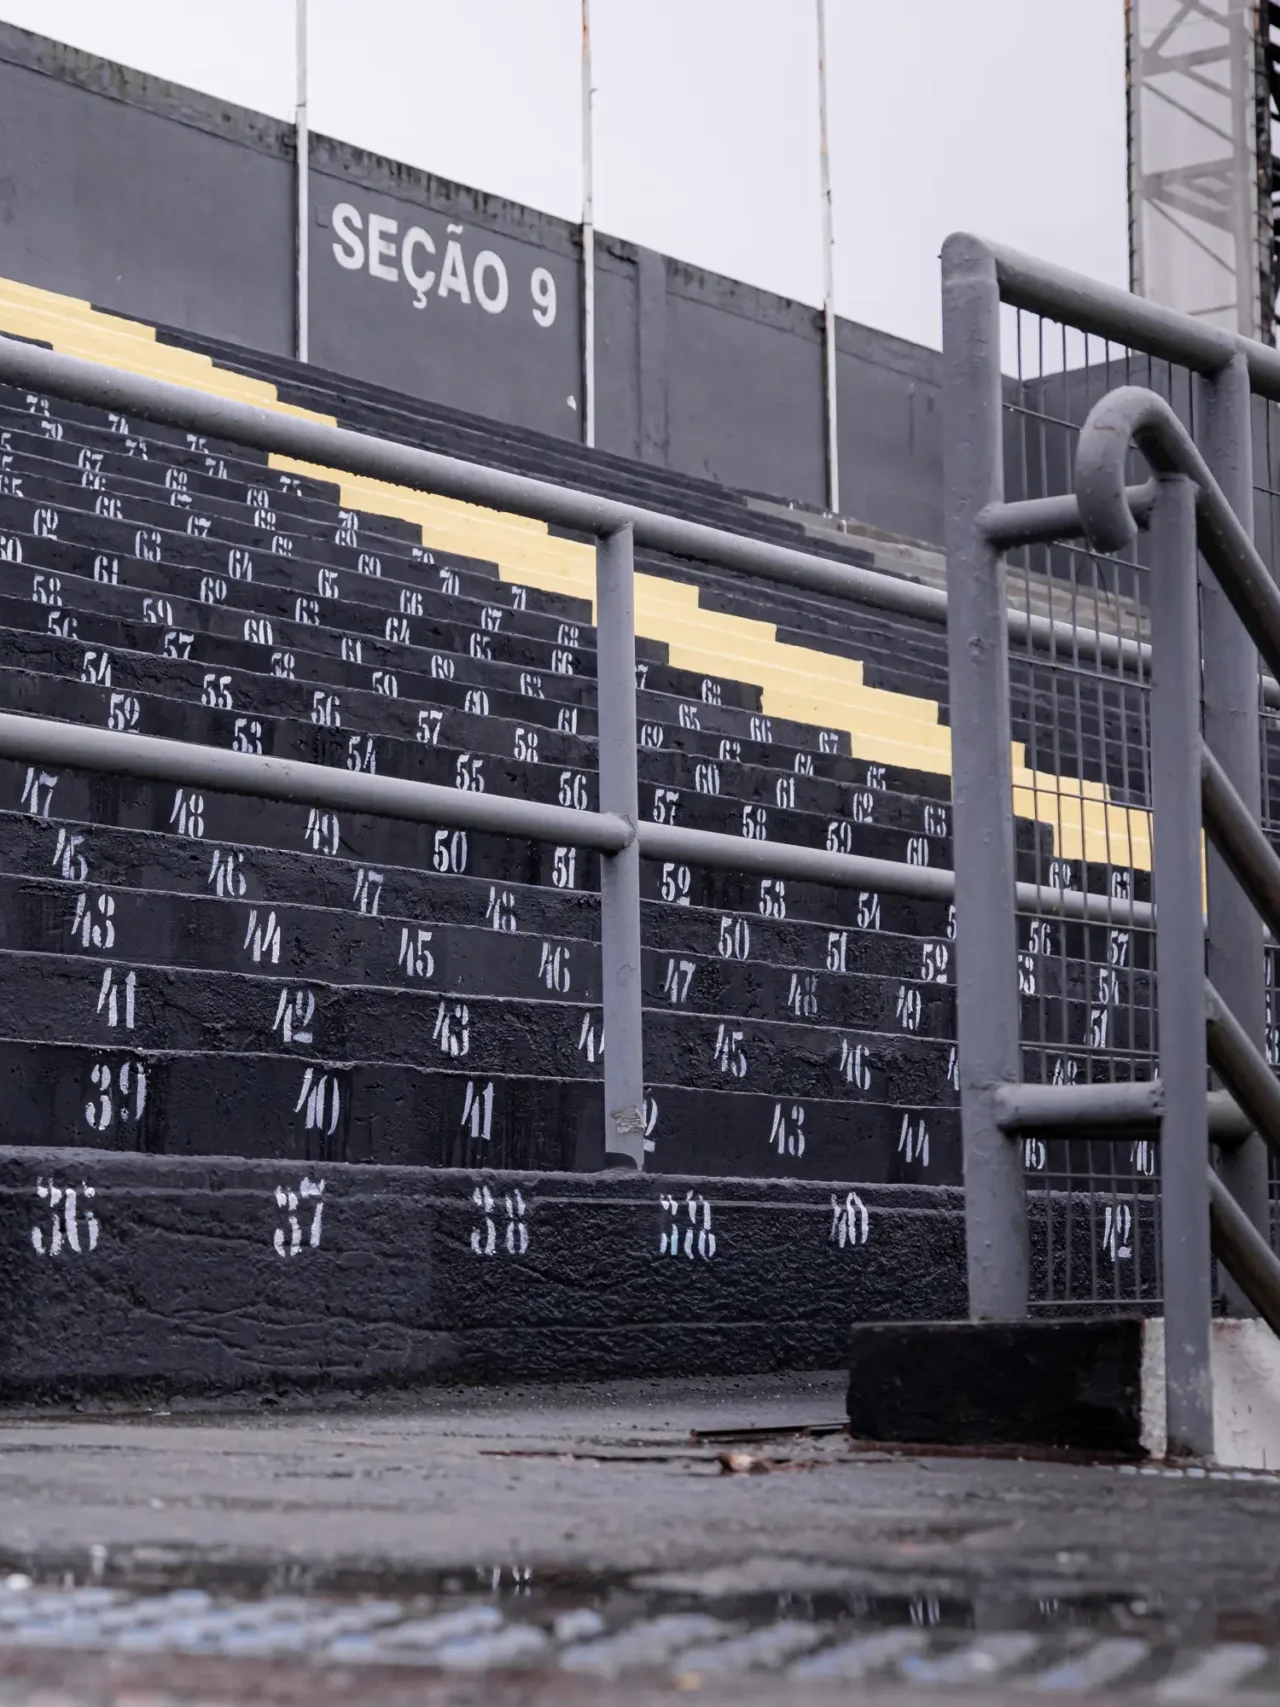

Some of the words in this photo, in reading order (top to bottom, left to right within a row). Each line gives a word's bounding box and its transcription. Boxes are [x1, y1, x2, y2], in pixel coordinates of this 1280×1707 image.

[332, 203, 509, 314] SEÇÃO
[531, 267, 557, 327] 9
[94, 556, 119, 586] 61
[228, 549, 252, 582] 64
[318, 569, 338, 599] 65
[144, 598, 173, 627] 59
[81, 651, 111, 687] 54
[201, 673, 232, 709] 55
[311, 691, 341, 727] 56
[232, 718, 262, 754] 53
[418, 711, 443, 745] 57
[514, 728, 538, 762] 58
[347, 736, 376, 774] 54
[456, 753, 484, 793] 55
[21, 767, 57, 818] 47
[558, 771, 587, 811] 56
[695, 764, 720, 796] 60
[776, 777, 795, 809] 61
[170, 789, 204, 837] 48
[652, 789, 679, 826] 57
[742, 805, 767, 841] 58
[853, 792, 873, 823] 62
[924, 806, 947, 837] 63
[305, 808, 339, 855] 49
[433, 830, 468, 873] 50
[826, 822, 852, 854] 59
[907, 837, 929, 867] 60
[53, 829, 88, 880] 45
[208, 850, 246, 897] 46
[552, 847, 576, 888] 51
[353, 868, 384, 915] 47
[661, 863, 691, 905] 52
[759, 879, 785, 919] 53
[72, 894, 115, 949] 43
[486, 886, 516, 931] 48
[857, 892, 881, 930] 54
[244, 910, 280, 963] 44
[398, 928, 435, 978] 45
[718, 916, 750, 960] 50
[826, 932, 847, 972] 51
[1028, 921, 1051, 955] 56
[1109, 931, 1129, 966] 57
[538, 942, 571, 992] 46
[664, 958, 695, 1002] 47
[921, 943, 948, 984] 52
[97, 968, 135, 1029] 41
[788, 973, 818, 1016] 48
[896, 985, 920, 1030] 49
[1099, 968, 1119, 1004] 54
[273, 987, 314, 1043] 42
[432, 1001, 469, 1057] 43
[714, 1023, 747, 1078] 45
[840, 1039, 871, 1090] 46
[85, 1061, 147, 1130] 39
[294, 1067, 339, 1135] 40
[461, 1081, 494, 1140] 41
[769, 1103, 805, 1158] 43
[898, 1114, 930, 1167] 44
[32, 1177, 98, 1256] 36
[273, 1177, 325, 1258] 37
[470, 1186, 528, 1255] 38
[829, 1191, 868, 1248] 40
[1103, 1205, 1131, 1262] 42
